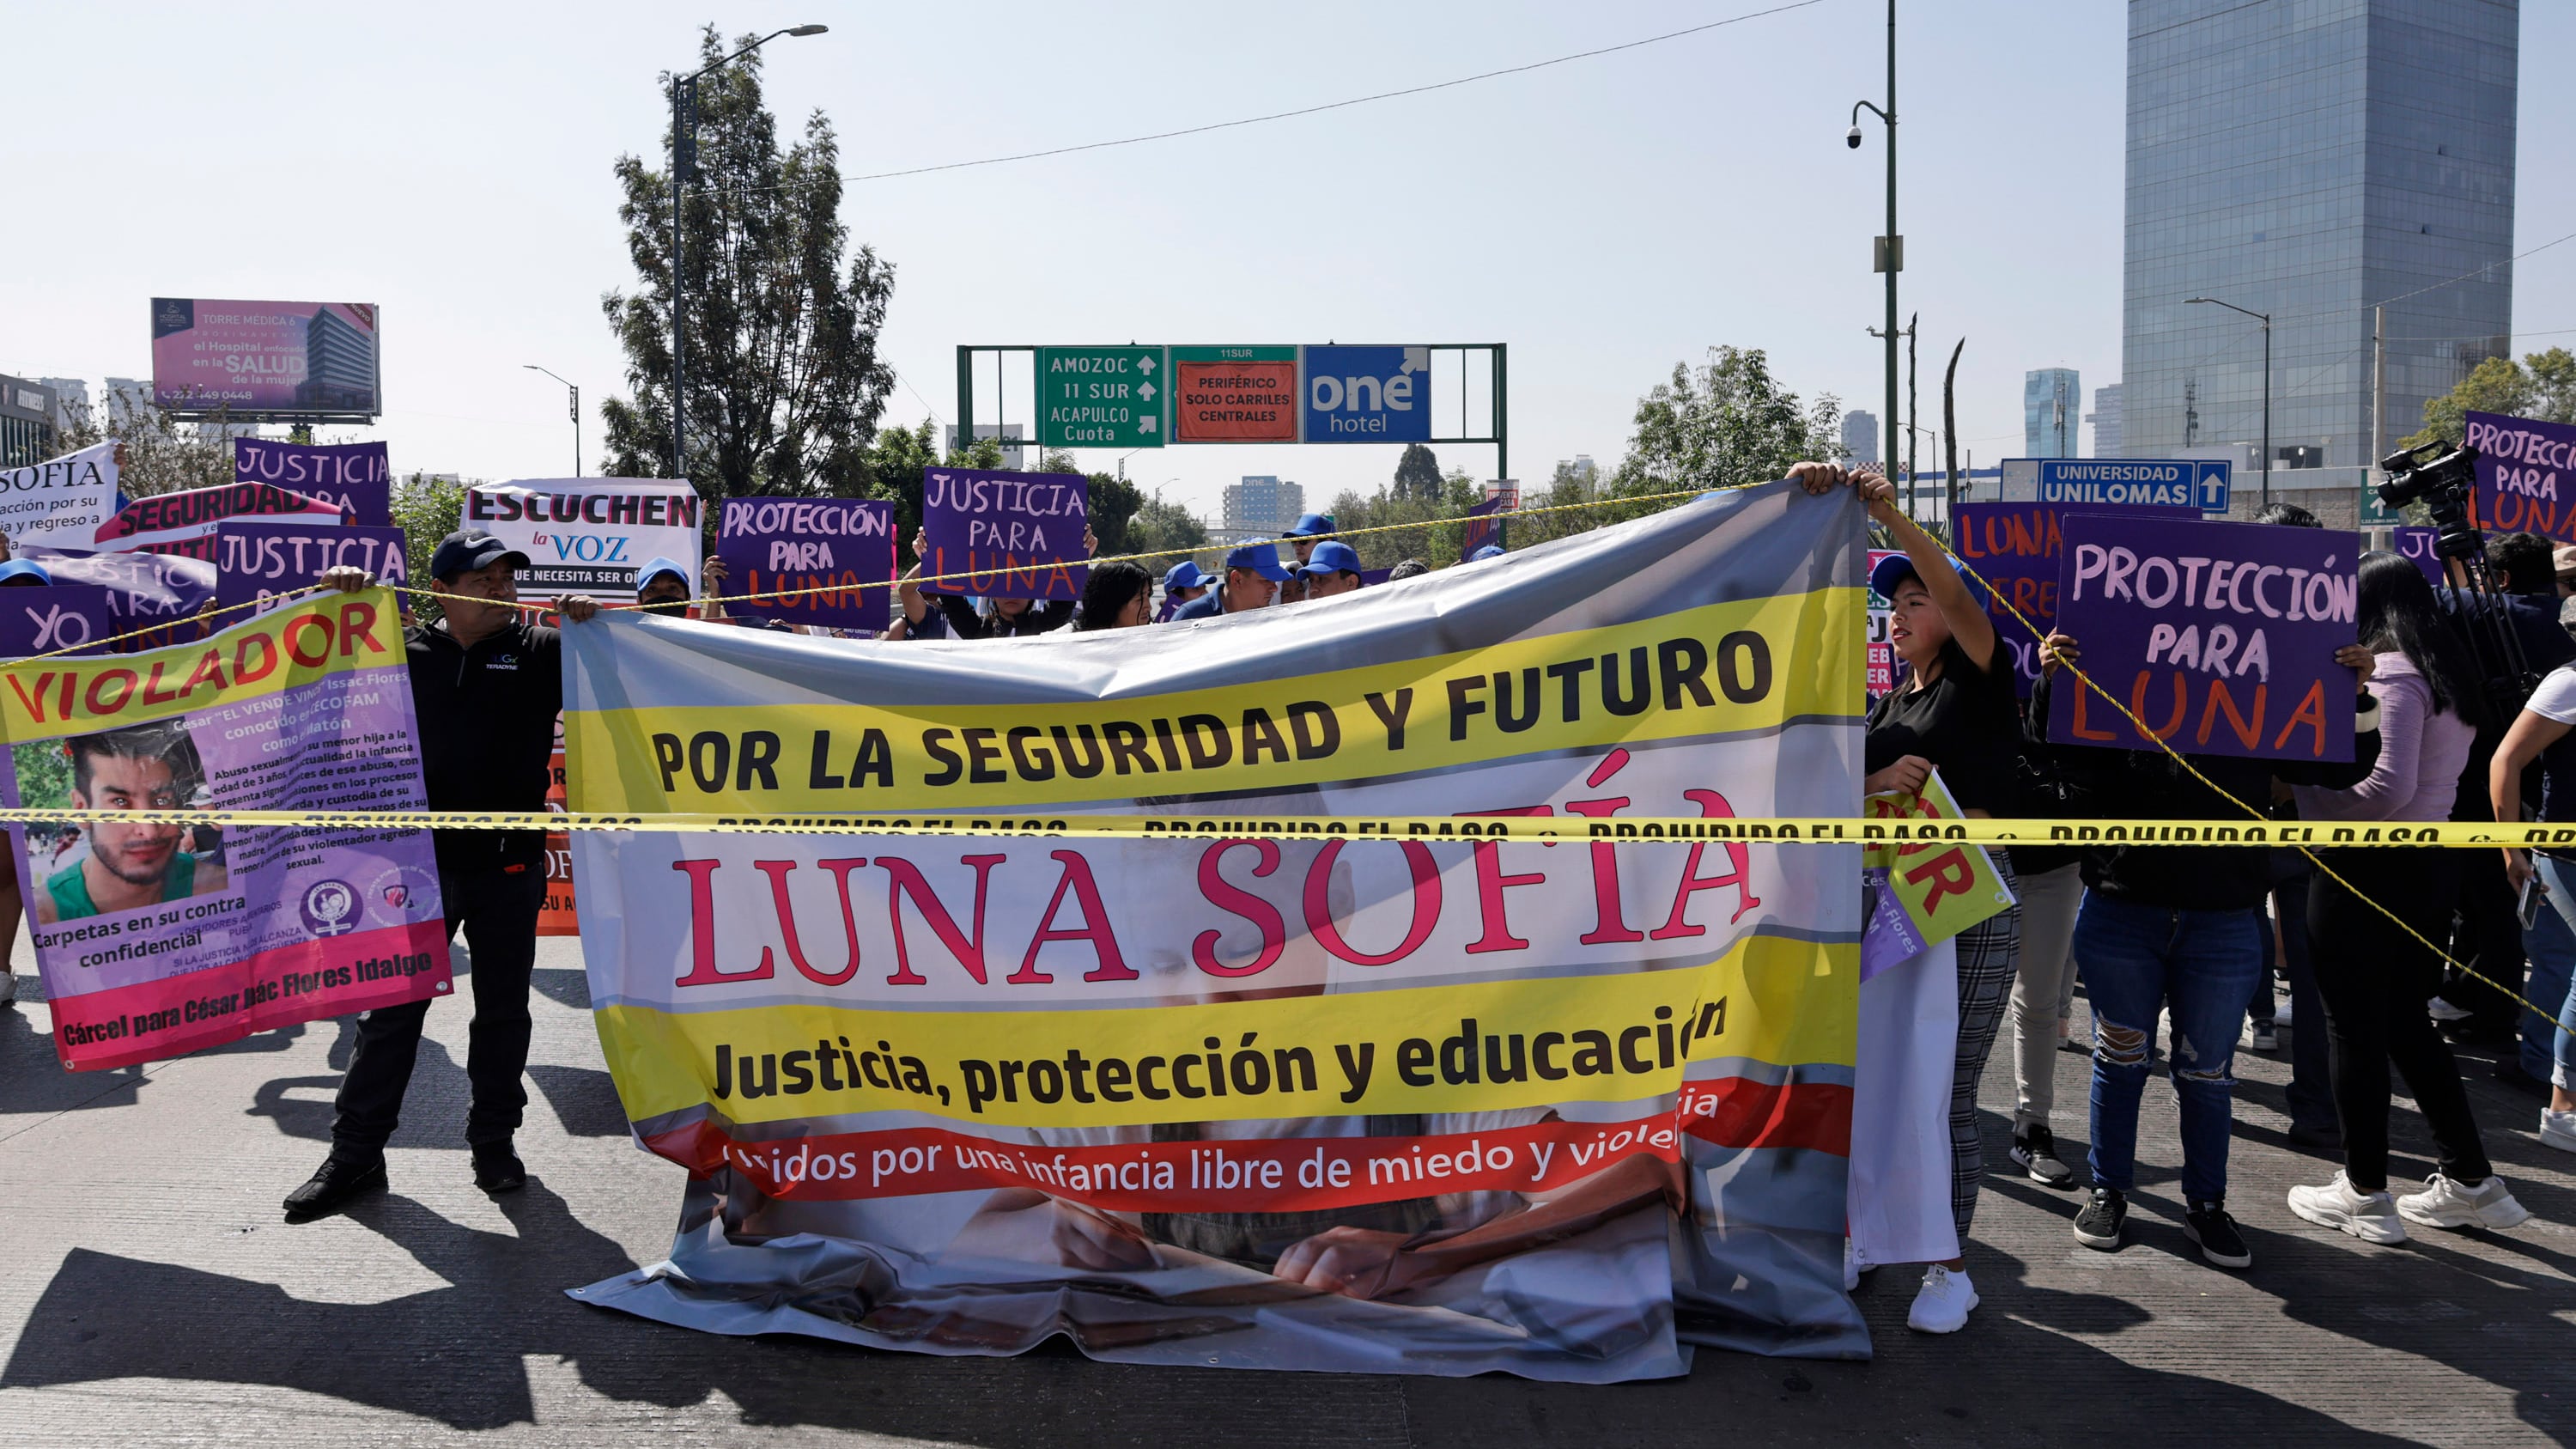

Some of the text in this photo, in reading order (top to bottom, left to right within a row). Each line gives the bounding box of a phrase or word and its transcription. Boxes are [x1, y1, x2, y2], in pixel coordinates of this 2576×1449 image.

[203, 313, 296, 326] TORRE MÉDICA 6
[350, 303, 372, 323] NUEVO
[192, 354, 307, 374] en la SALUD
[209, 342, 261, 354] Hospital
[232, 374, 248, 385] de
[251, 374, 263, 385] la
[1050, 356, 1128, 374] AMOZOC
[1199, 374, 1277, 388] PERIFÉRICO
[222, 390, 252, 400] 0448
[1064, 383, 1129, 399] 11 SUR
[1186, 394, 1290, 405] SOLO CARRILES
[1050, 406, 1129, 423] ACAPULCO
[1199, 411, 1277, 422] CENTRALES
[1330, 413, 1387, 433] hotel
[1064, 425, 1115, 441] Cuota
[237, 447, 391, 484] JUSTICIA
[2057, 465, 2178, 482] UNIVERSIDAD
[927, 473, 1086, 517] JUSTICIA
[2044, 483, 2188, 505] UNILOMAS
[2496, 464, 2557, 502] PARA
[50, 496, 76, 513] por
[80, 496, 98, 508] su
[118, 483, 311, 537] SEGURIDAD
[469, 488, 698, 528] ESCUCHEN
[723, 502, 887, 539] PROTECCIÓN
[15, 514, 100, 535] y regreso a
[969, 519, 1047, 552] PARA
[1961, 508, 2062, 558] LUNA
[219, 534, 405, 582] JUSTICIA
[532, 531, 630, 563] la VOZ
[769, 540, 834, 572] PARA
[534, 569, 593, 583] NECESITA
[597, 570, 621, 584] SER
[935, 546, 1077, 596] LUNA
[2072, 543, 2358, 625] PROTECCIÓN
[749, 569, 864, 611] LUNA
[25, 604, 91, 650] YO
[7, 602, 386, 724] VIOLADOR
[2147, 623, 2269, 684] PARA
[173, 716, 214, 733] Cesar
[242, 695, 293, 715] VENDE
[327, 677, 366, 691] Issac
[367, 671, 409, 685] Flores
[652, 630, 1774, 795] POR LA SEGURIDAD Y FUTURO
[2071, 670, 2327, 758] LUNA
[224, 713, 298, 741] conocido
[215, 729, 407, 782] Abuso su menor hija a la
[261, 735, 298, 753] como
[213, 781, 240, 795] edad
[242, 778, 256, 788] de
[258, 776, 264, 786] 3
[355, 749, 367, 758] la
[369, 742, 414, 758] infancia
[214, 791, 261, 812] presenta
[319, 766, 334, 778] de
[337, 764, 357, 776] ese
[359, 760, 398, 773] abuso,
[399, 757, 419, 767] con
[331, 770, 418, 790] en los procesos
[317, 798, 325, 809] y
[327, 789, 377, 806] custodia
[380, 788, 394, 798] de
[397, 787, 410, 795] su
[398, 798, 428, 809] de su
[224, 836, 253, 849] menor
[254, 831, 270, 843] hija
[234, 862, 261, 876] menor
[281, 847, 293, 858] de
[293, 844, 306, 855] su
[307, 832, 377, 851] violentador
[379, 827, 422, 843] agresor
[286, 855, 325, 871] sexual.
[672, 747, 1761, 989] LUNA SOFÍA
[33, 921, 122, 950] Carpetas
[127, 916, 153, 933] en
[158, 910, 180, 927] su
[185, 895, 246, 921] contra
[185, 916, 238, 936] DEUDORES
[1885, 908, 1917, 955] Flores
[80, 928, 203, 969] confidencial
[185, 954, 198, 967] LA
[199, 944, 241, 963] JUSTICIA
[257, 927, 303, 945] ALCANZA
[64, 952, 434, 1047] Cárcel para César Flores Idalgo
[713, 995, 1728, 1114] Justicia, protección y educación
[871, 1143, 942, 1187] por
[954, 1143, 1018, 1175] una
[1024, 1149, 1176, 1192] infancia
[1190, 1148, 1284, 1190] libre
[1297, 1145, 1352, 1190] de
[1370, 1136, 1516, 1185] miedo
[1528, 1139, 1555, 1181] y
